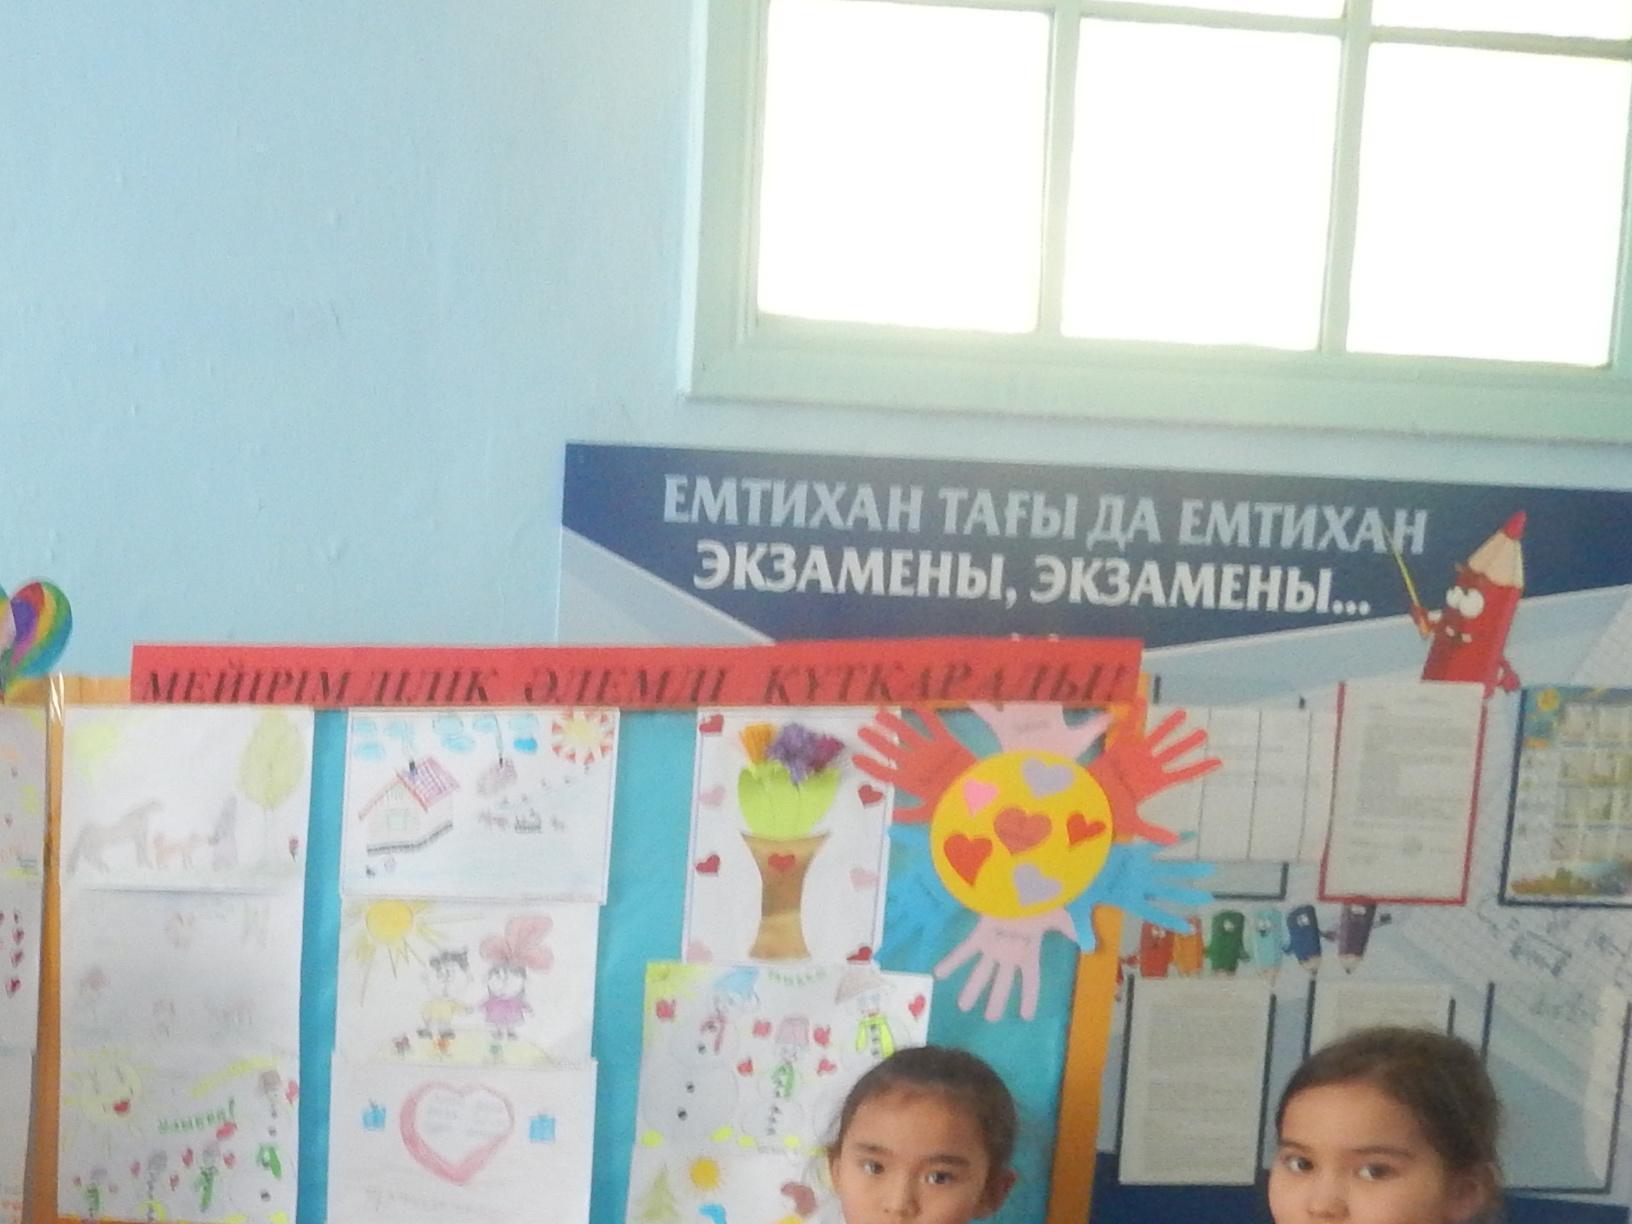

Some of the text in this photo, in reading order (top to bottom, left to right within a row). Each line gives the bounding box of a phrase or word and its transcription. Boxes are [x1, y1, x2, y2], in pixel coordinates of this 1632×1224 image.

[663, 473, 1432, 556] ЕМТИХАН ТАҒЫ ДА ЕМТИХАН
[691, 538, 1373, 616] ЭКЗАМЕНЫ, ЭКЗАМЕНЫ...
